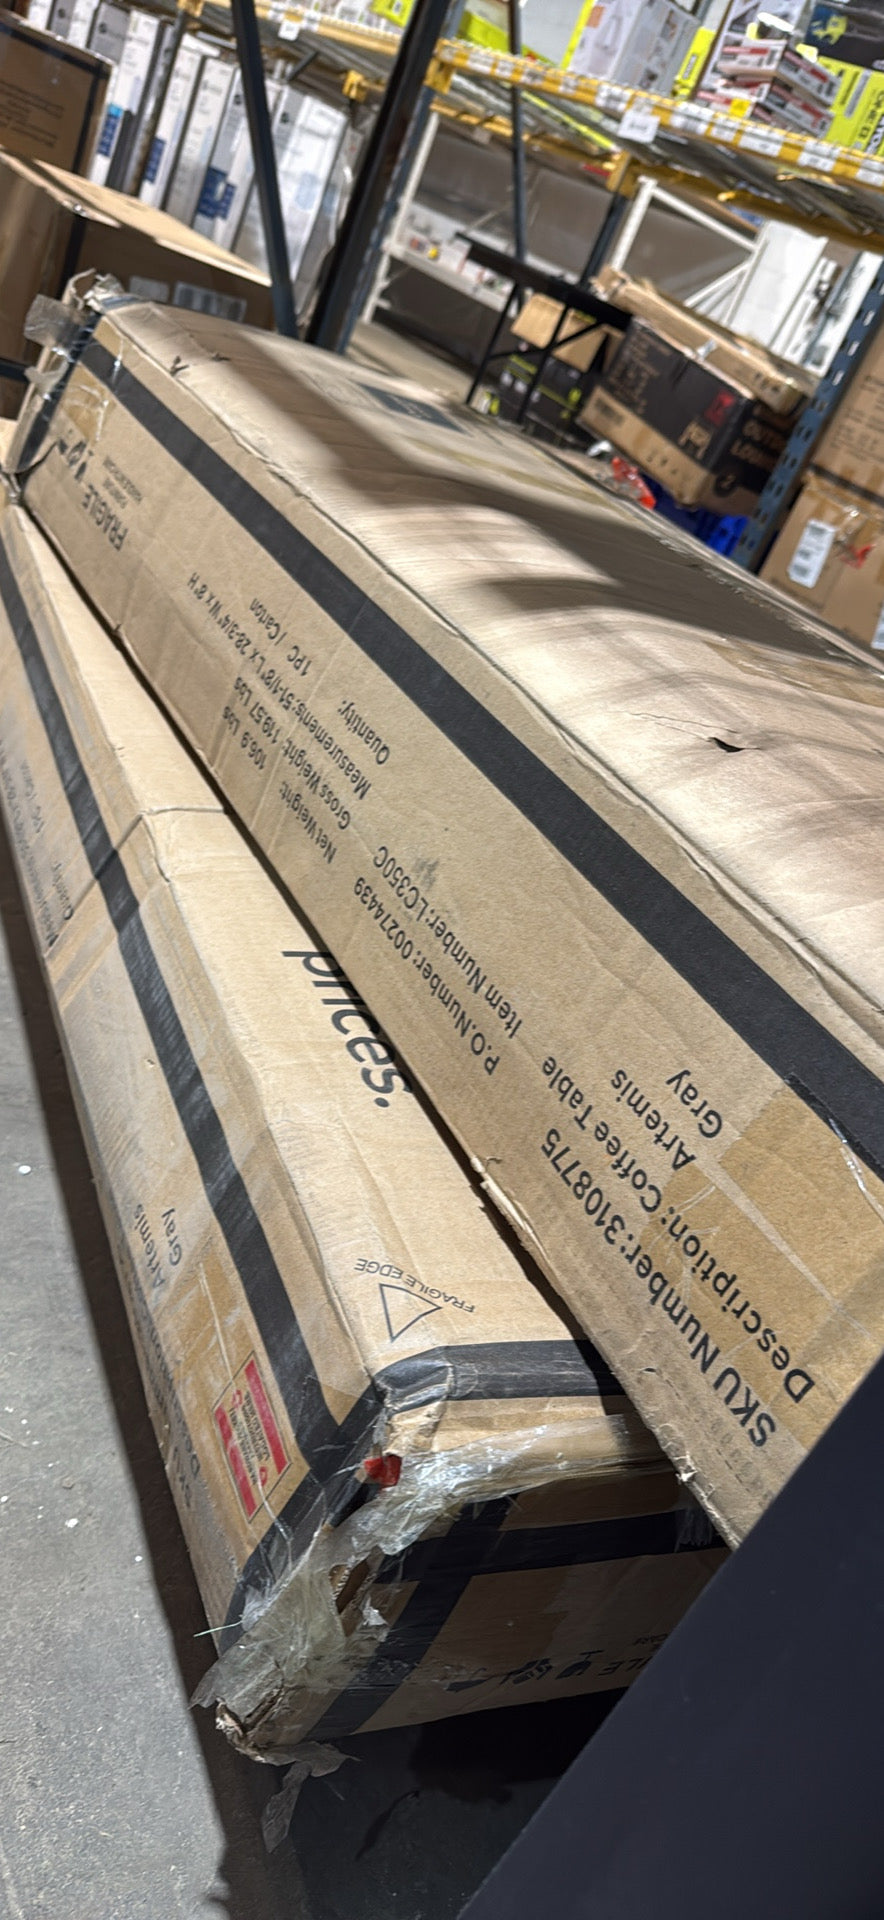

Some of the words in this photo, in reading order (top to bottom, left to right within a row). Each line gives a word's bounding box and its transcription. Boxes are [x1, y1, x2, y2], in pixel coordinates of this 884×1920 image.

[82, 485, 127, 551] FRAGILE
[250, 599, 280, 639] Carton
[288, 646, 311, 676] 1PC
[234, 677, 252, 706] Lbs
[223, 706, 240, 735] Lbs
[250, 702, 280, 743] 119.57
[338, 701, 389, 764] Quantity:
[242, 732, 266, 769] 106.9
[284, 740, 320, 794] Weight:
[320, 785, 350, 829] Gross
[355, 877, 413, 959] 00274439
[485, 985, 522, 1038] Item
[543, 1057, 592, 1130] Table
[611, 1070, 696, 1170] Artemis
[666, 1070, 722, 1138] Gray
[541, 1129, 625, 1243] 3108775
[595, 1122, 661, 1212] Coffee
[135, 1204, 165, 1287] Artemis
[162, 1208, 181, 1265] Gray
[355, 1259, 404, 1279] EDGE
[405, 1275, 475, 1312] FRAGILE
[661, 1207, 815, 1403] Description:
[713, 1368, 775, 1446] SKU
